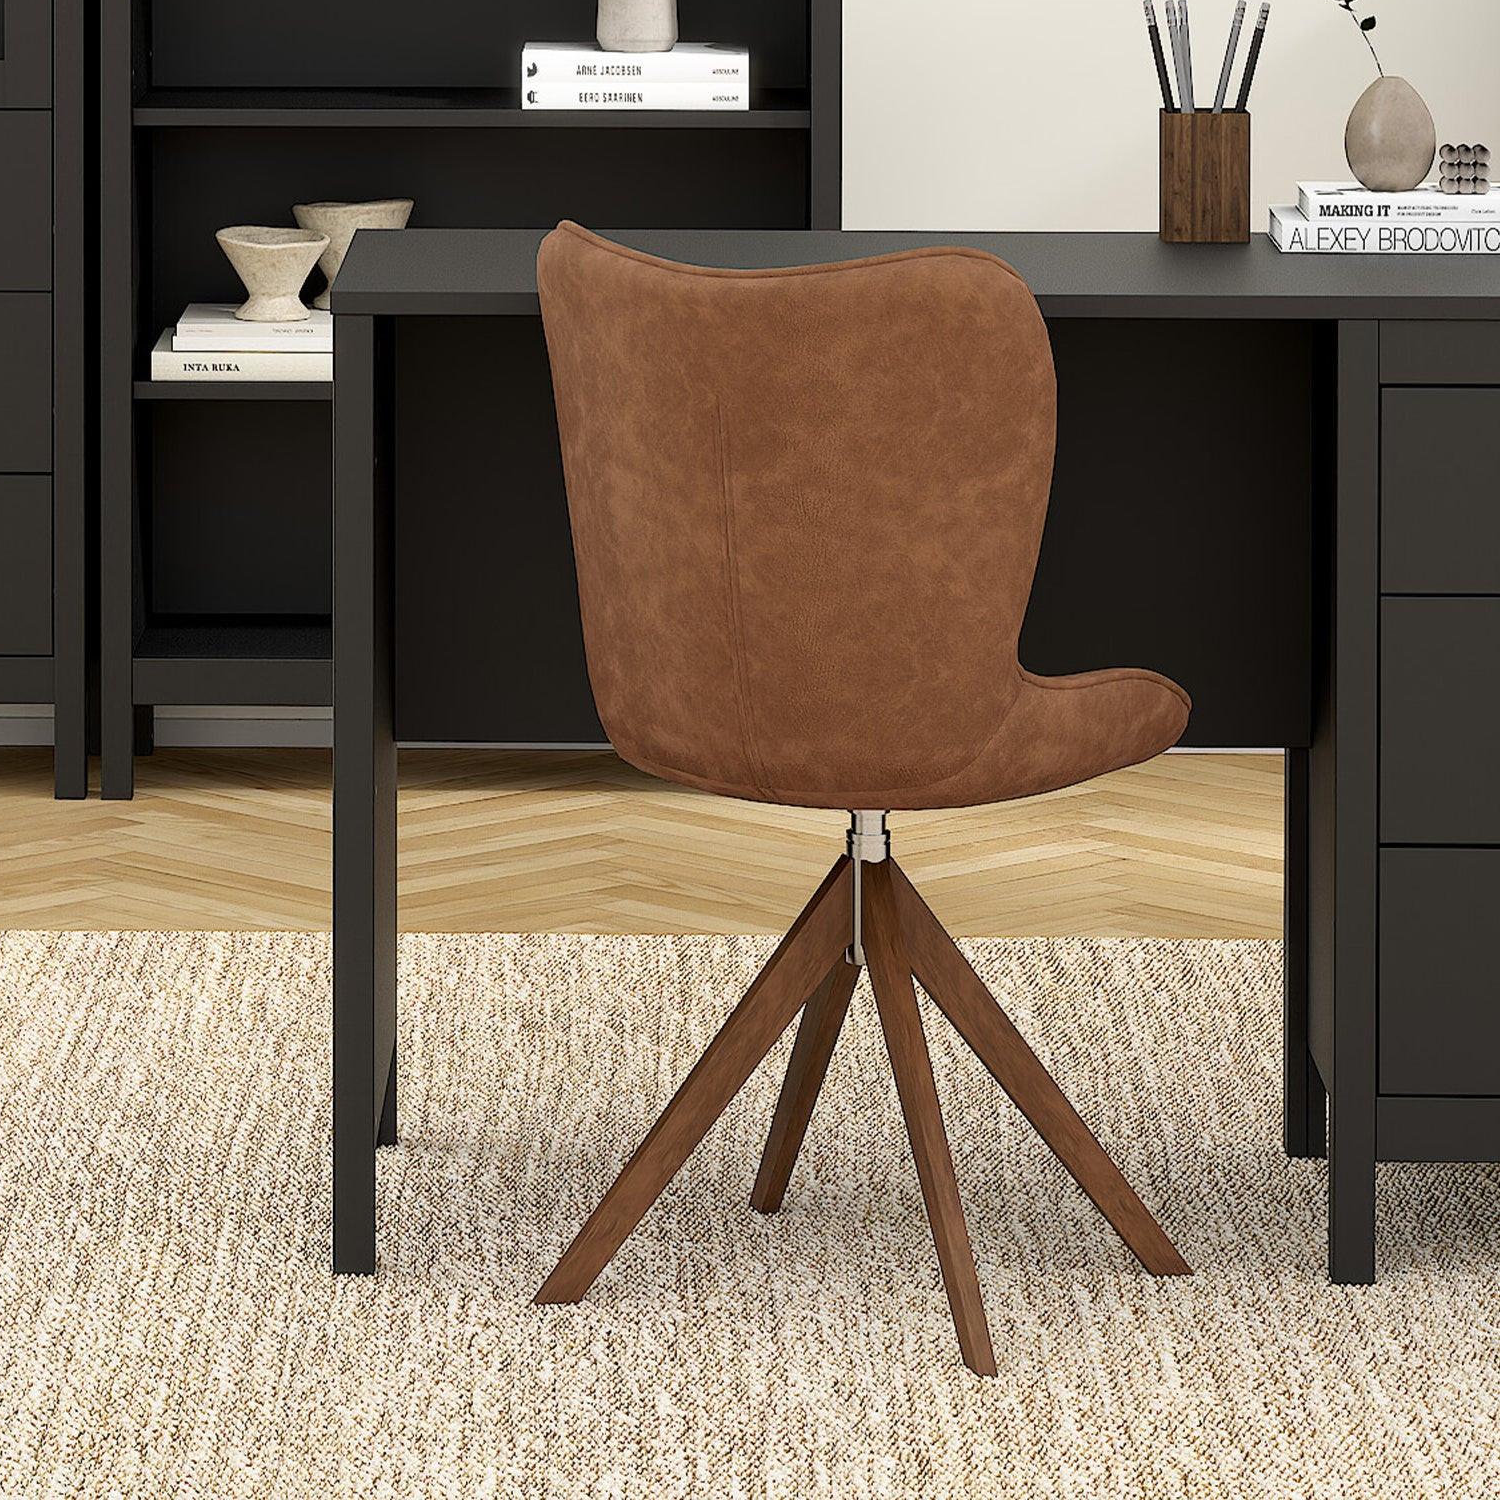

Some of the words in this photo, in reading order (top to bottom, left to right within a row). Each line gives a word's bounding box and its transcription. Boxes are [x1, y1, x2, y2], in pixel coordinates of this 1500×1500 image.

[576, 65, 597, 76] ARNE
[600, 65, 642, 76] JACOBSEN
[579, 92, 600, 103] EERO
[602, 92, 643, 103] SAARINEN
[1319, 205, 1374, 217] MAKING
[1377, 205, 1390, 217] IT
[1289, 227, 1371, 250] ALEXEY
[1379, 227, 1500, 251] BRODOVITC
[183, 364, 209, 372] INTA
[212, 364, 240, 372] RUKA
